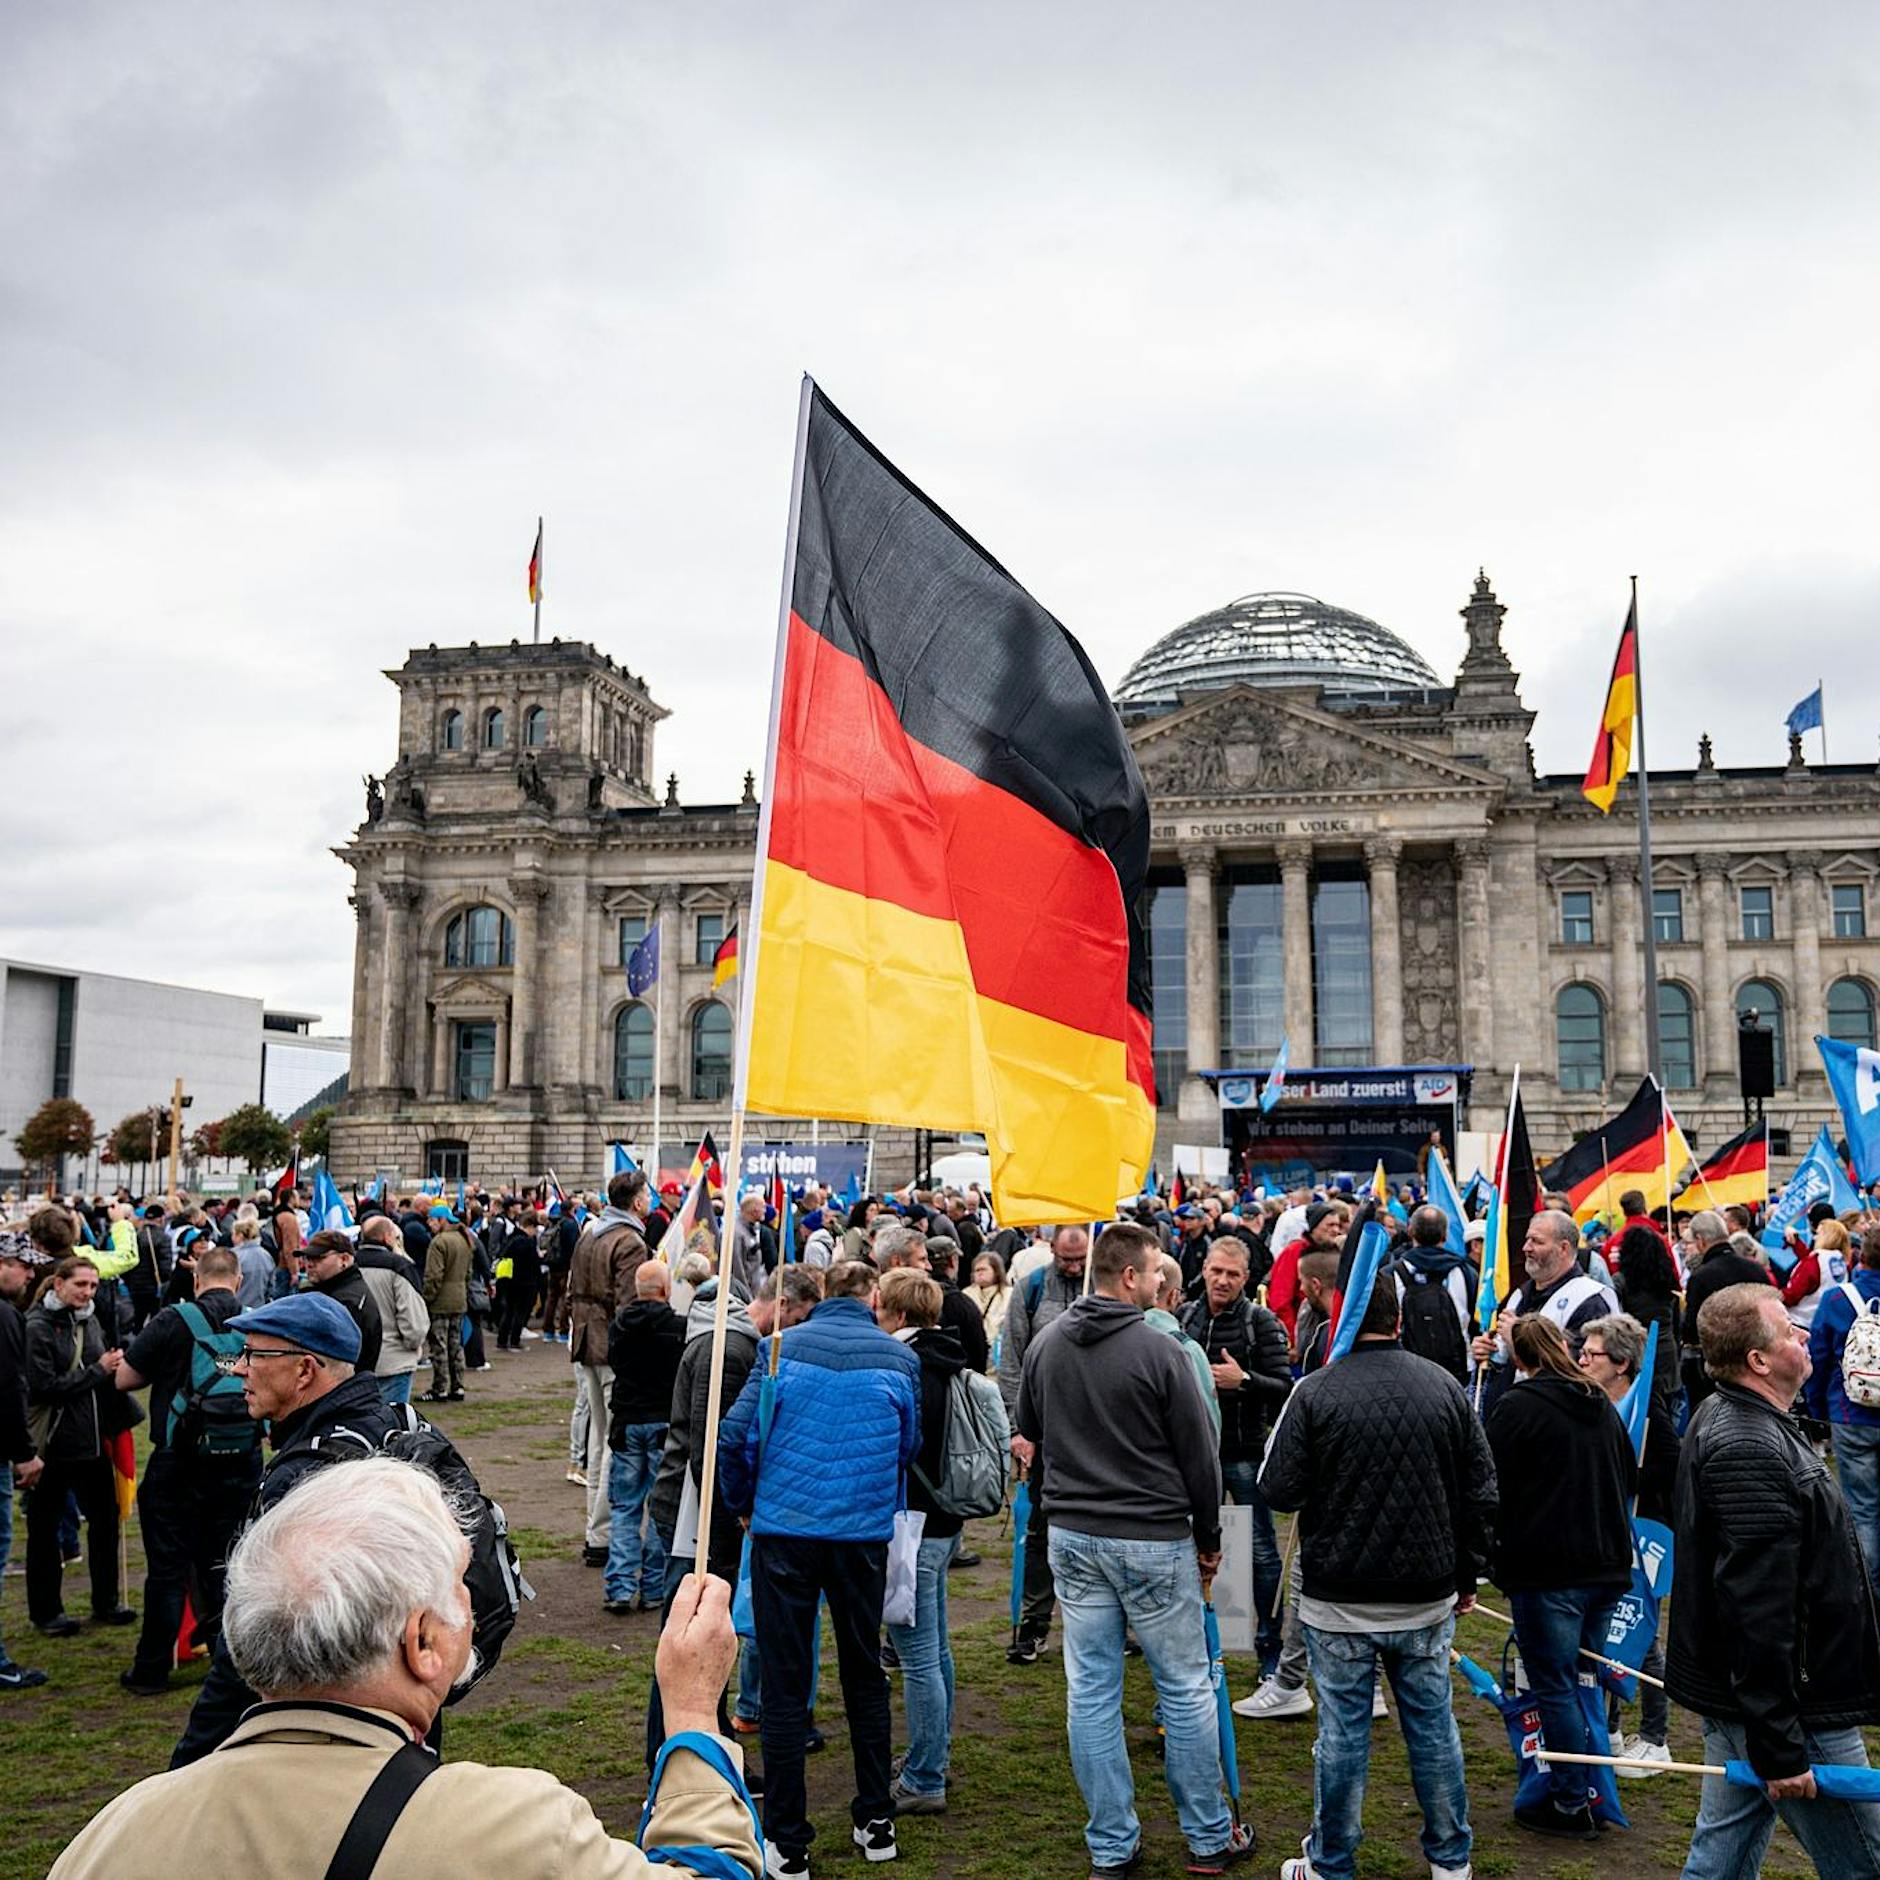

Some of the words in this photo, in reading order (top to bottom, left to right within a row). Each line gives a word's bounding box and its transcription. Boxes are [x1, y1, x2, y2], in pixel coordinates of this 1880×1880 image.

[1152, 824, 1177, 838] EM
[1190, 821, 1286, 837] DEUTSCHEN
[1300, 819, 1350, 833] VOLKE
[1310, 1081, 1349, 1098] Land
[1352, 1080, 1407, 1097] zuerst!
[1248, 1121, 1271, 1136] Wir
[1275, 1119, 1324, 1136] stehen
[1328, 1123, 1346, 1135] an
[1350, 1119, 1396, 1135] Deiner
